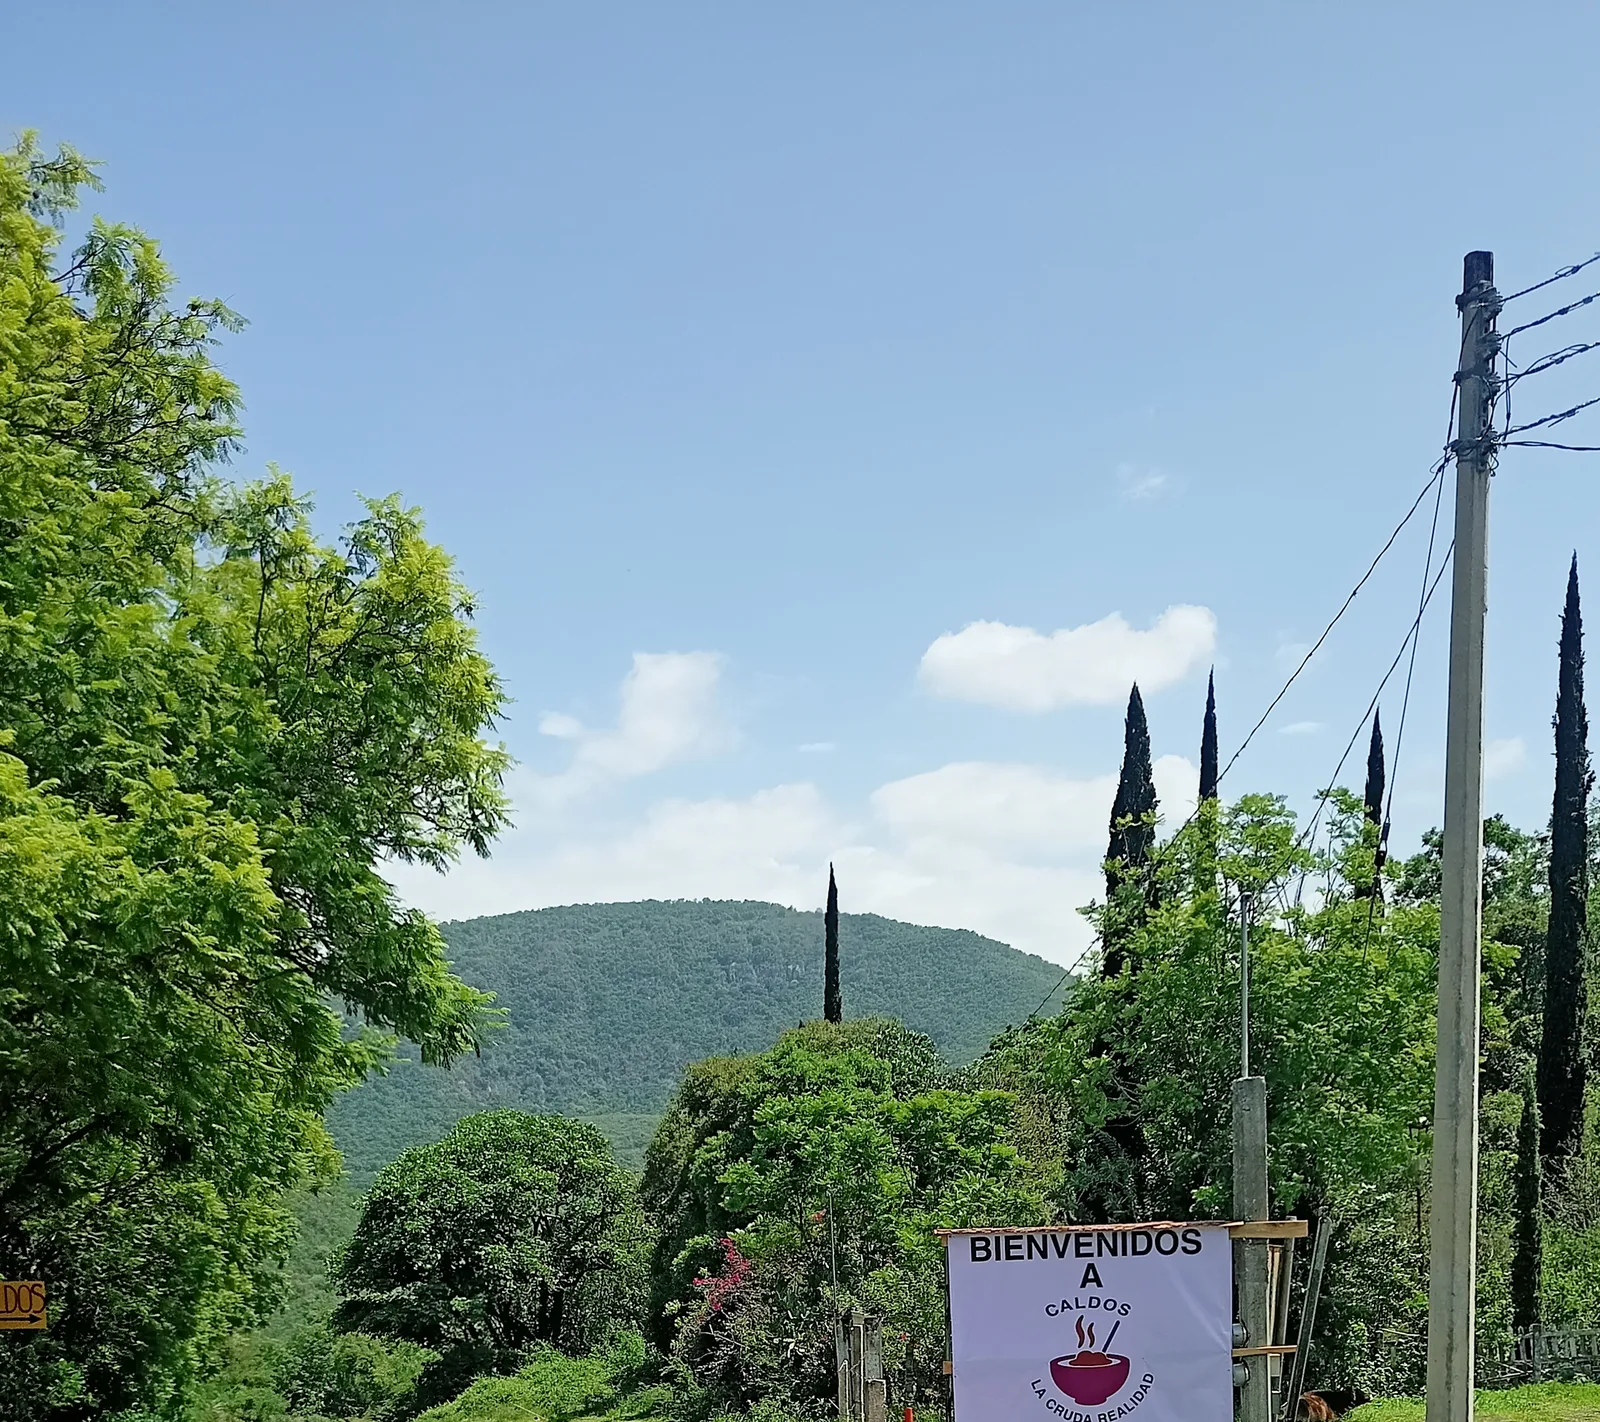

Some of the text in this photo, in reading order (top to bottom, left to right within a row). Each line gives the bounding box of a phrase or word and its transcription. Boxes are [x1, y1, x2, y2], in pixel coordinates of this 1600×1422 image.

[970, 1229, 1203, 1262] BIENVENIDOS
[1080, 1262, 1104, 1289] A
[0, 1283, 46, 1314] DOS
[1045, 1296, 1132, 1317] CALDOS
[1030, 1379, 1047, 1400] LA
